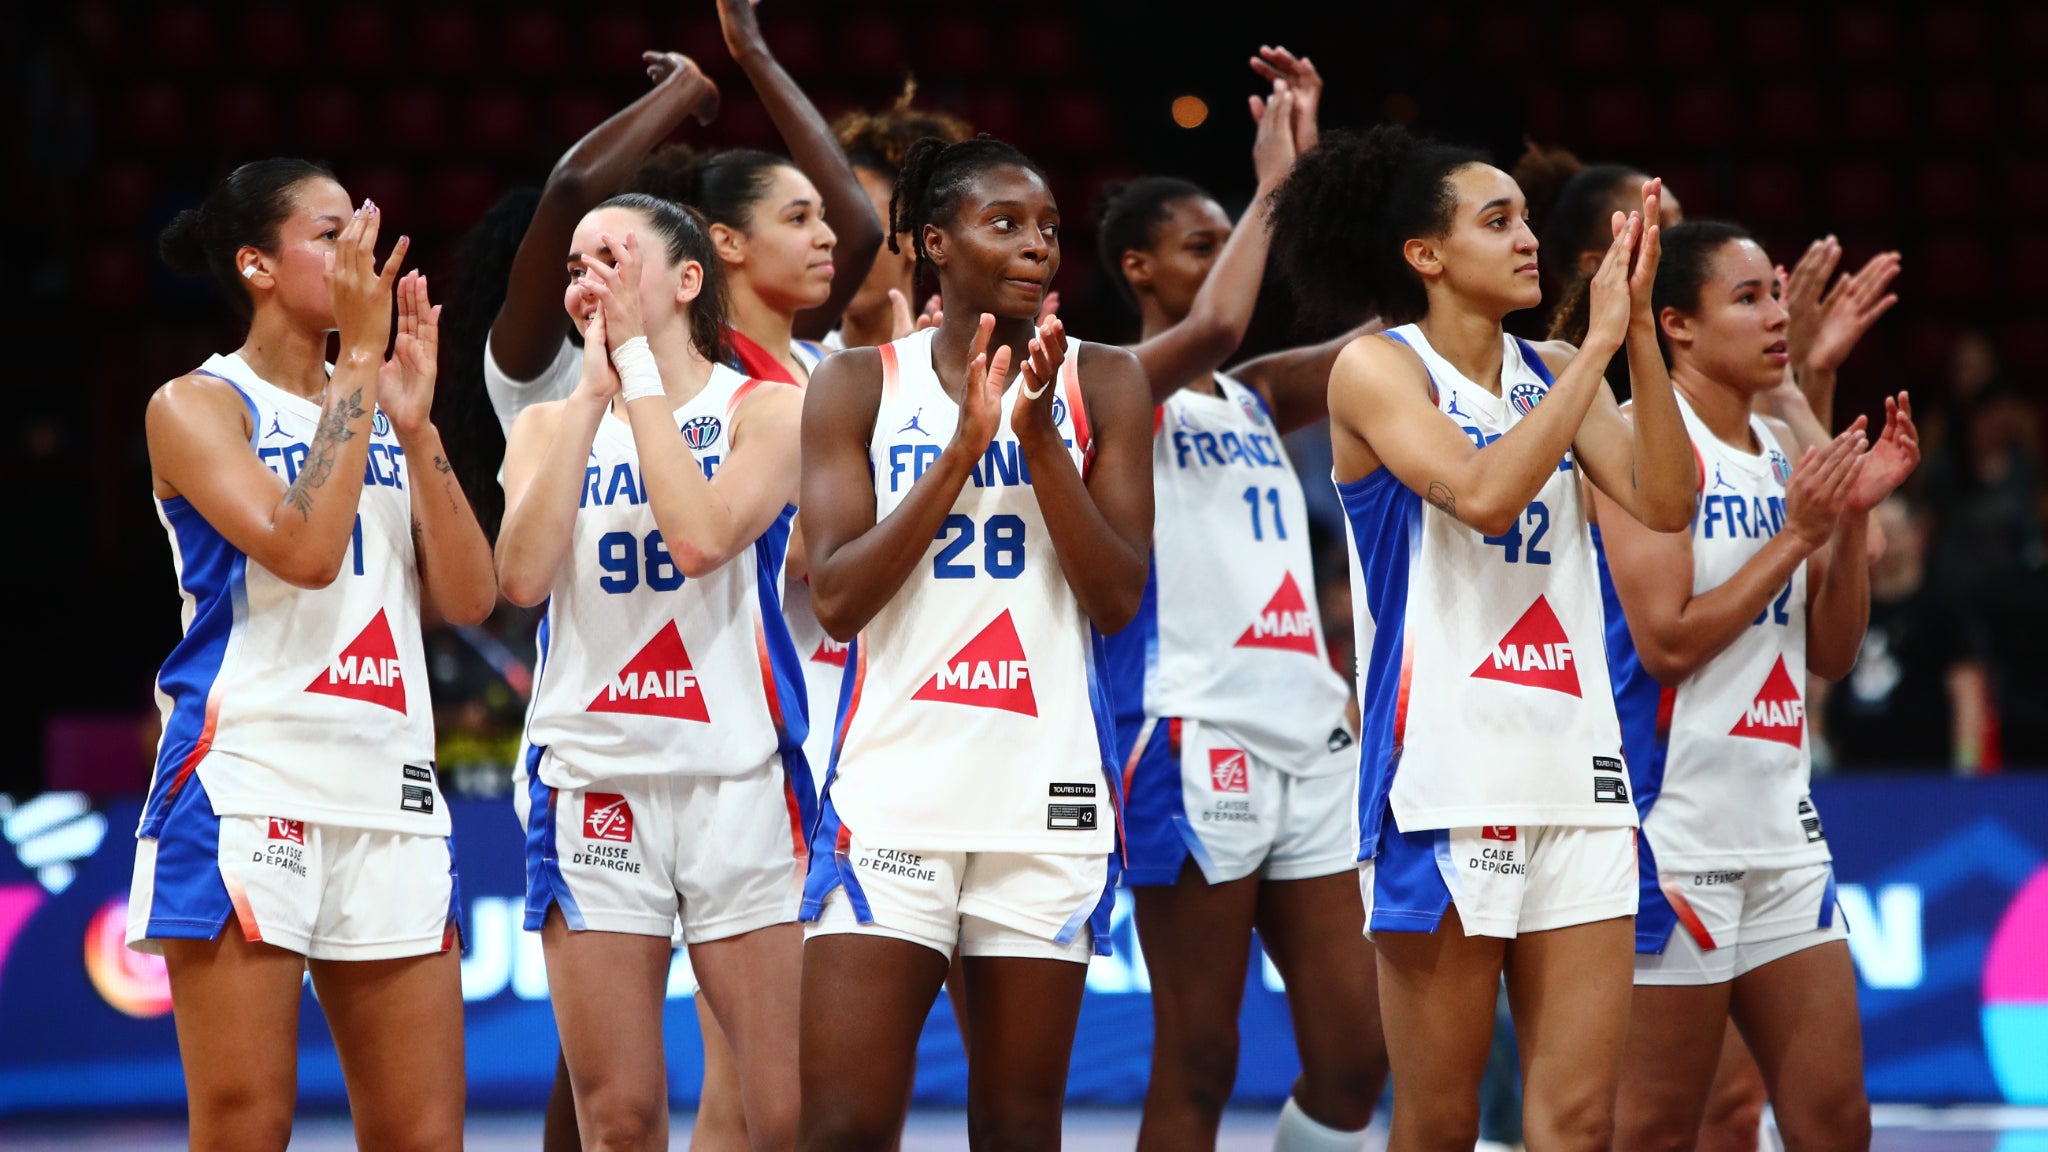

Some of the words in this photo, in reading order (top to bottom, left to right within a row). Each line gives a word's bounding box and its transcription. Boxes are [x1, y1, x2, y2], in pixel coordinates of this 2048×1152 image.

[1173, 432, 1285, 469] FRANC
[1243, 486, 1287, 541] 11
[1705, 494, 1787, 539] FRAN
[934, 514, 1026, 579] 28
[1484, 501, 1551, 566] 42
[598, 529, 686, 594] 98
[1254, 611, 1312, 639] MAIF
[1491, 642, 1573, 671] MAIF
[328, 655, 401, 687] MAIF
[936, 660, 1028, 690] MAIF
[608, 669, 696, 702] MAIF
[1746, 700, 1804, 728] MAIF
[1053, 786, 1074, 794] TOUTES
[1081, 811, 1092, 822] 42
[252, 851, 307, 878] D'EPARGNE
[268, 844, 303, 861] CAISSE
[573, 853, 641, 874] D'EPARGNE
[587, 844, 629, 859] CAISSE
[877, 848, 922, 866] CAISSE
[858, 857, 936, 882] D'EPARGNE
